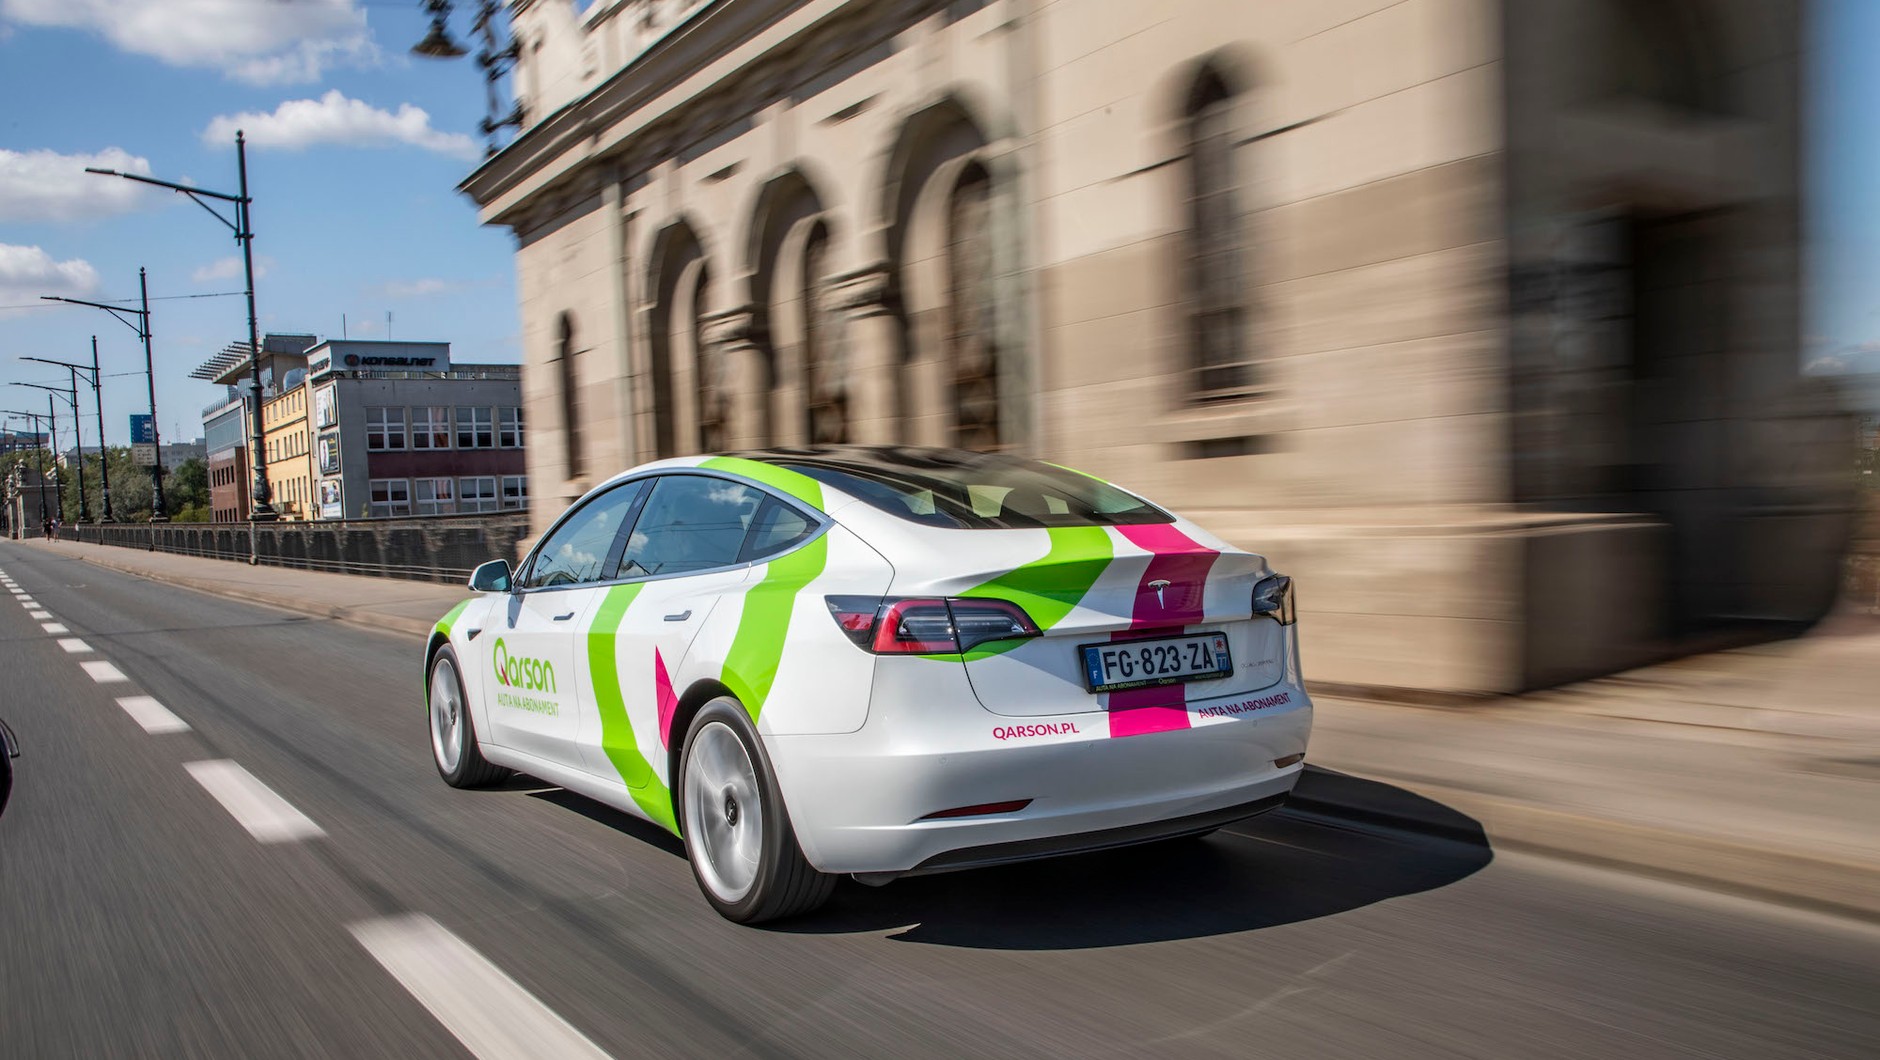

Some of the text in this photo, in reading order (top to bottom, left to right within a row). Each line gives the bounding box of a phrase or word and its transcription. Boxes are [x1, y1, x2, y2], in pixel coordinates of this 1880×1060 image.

[493, 637, 557, 694] Qarson
[1217, 656, 1227, 669] 77
[1198, 692, 1291, 719] AUTA NA ABONAMENT
[993, 722, 1080, 740] QARSON.PL
